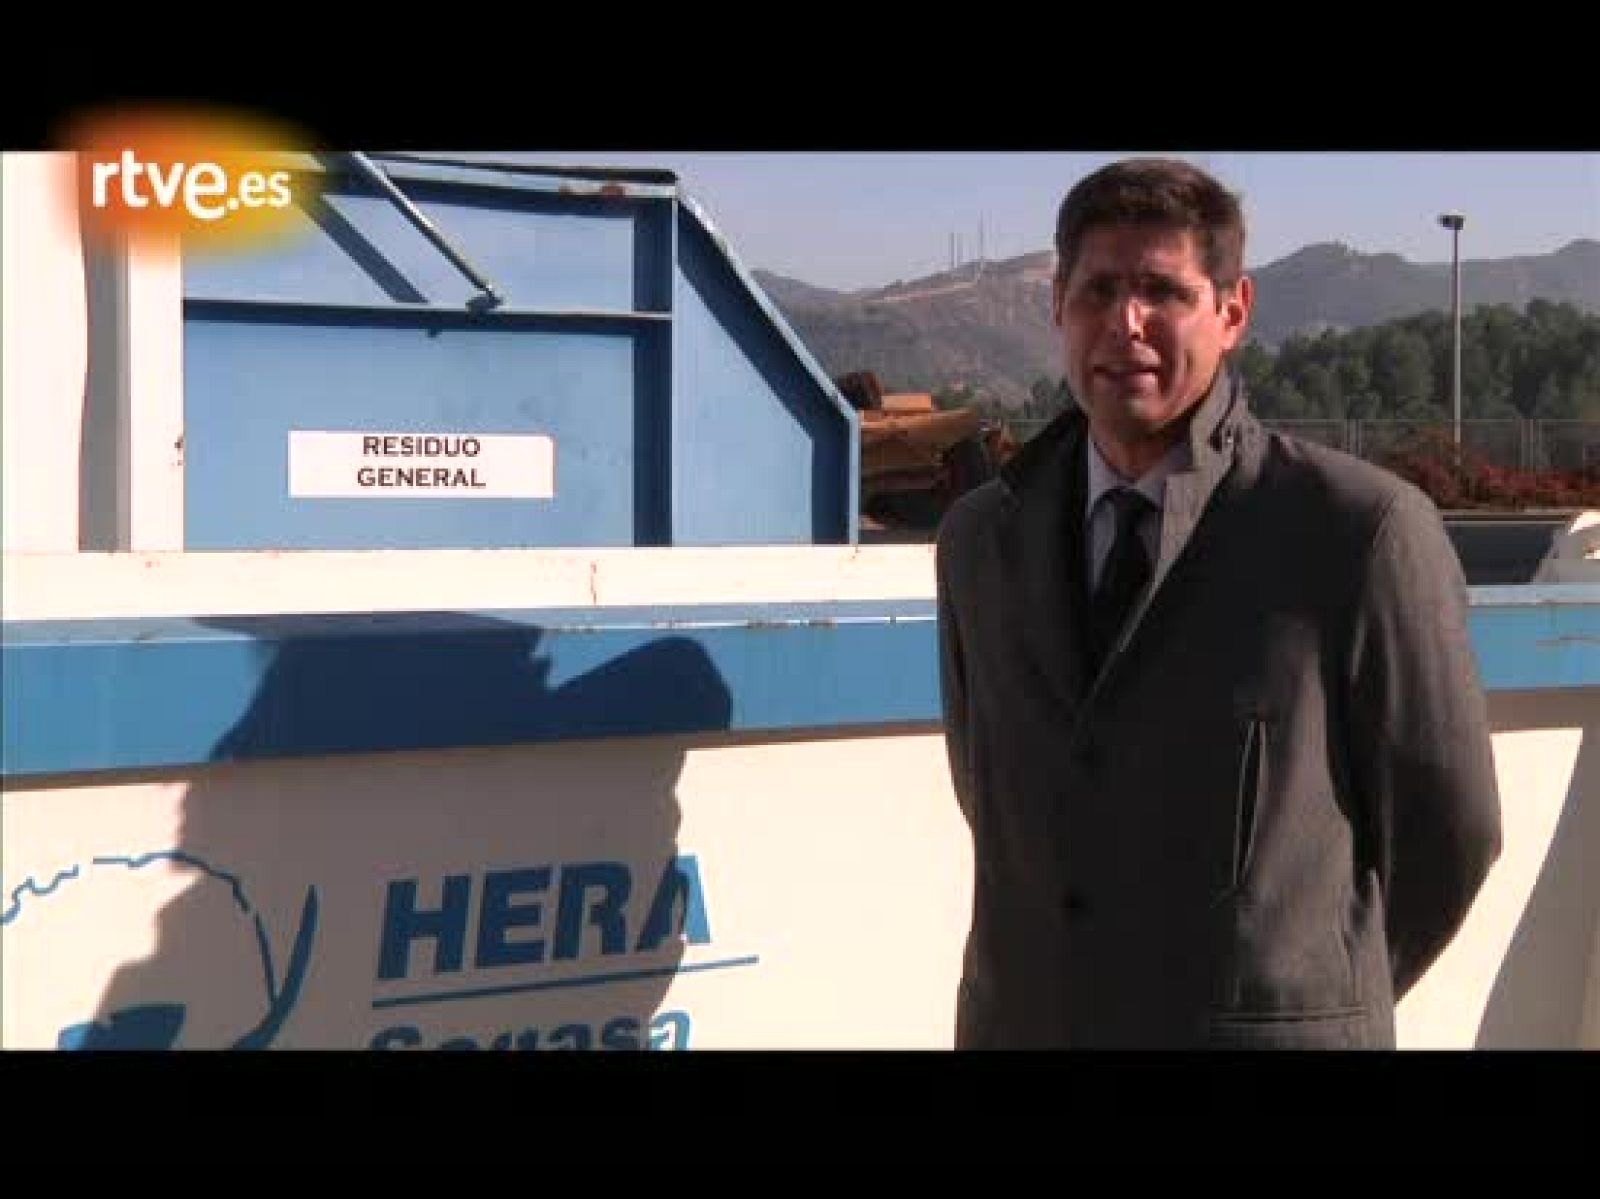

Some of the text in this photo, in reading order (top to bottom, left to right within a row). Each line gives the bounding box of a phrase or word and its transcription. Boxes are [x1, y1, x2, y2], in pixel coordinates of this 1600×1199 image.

[363, 435, 481, 457] RESIDUO
[357, 467, 487, 488] GENERAL
[377, 855, 711, 978] HERA
